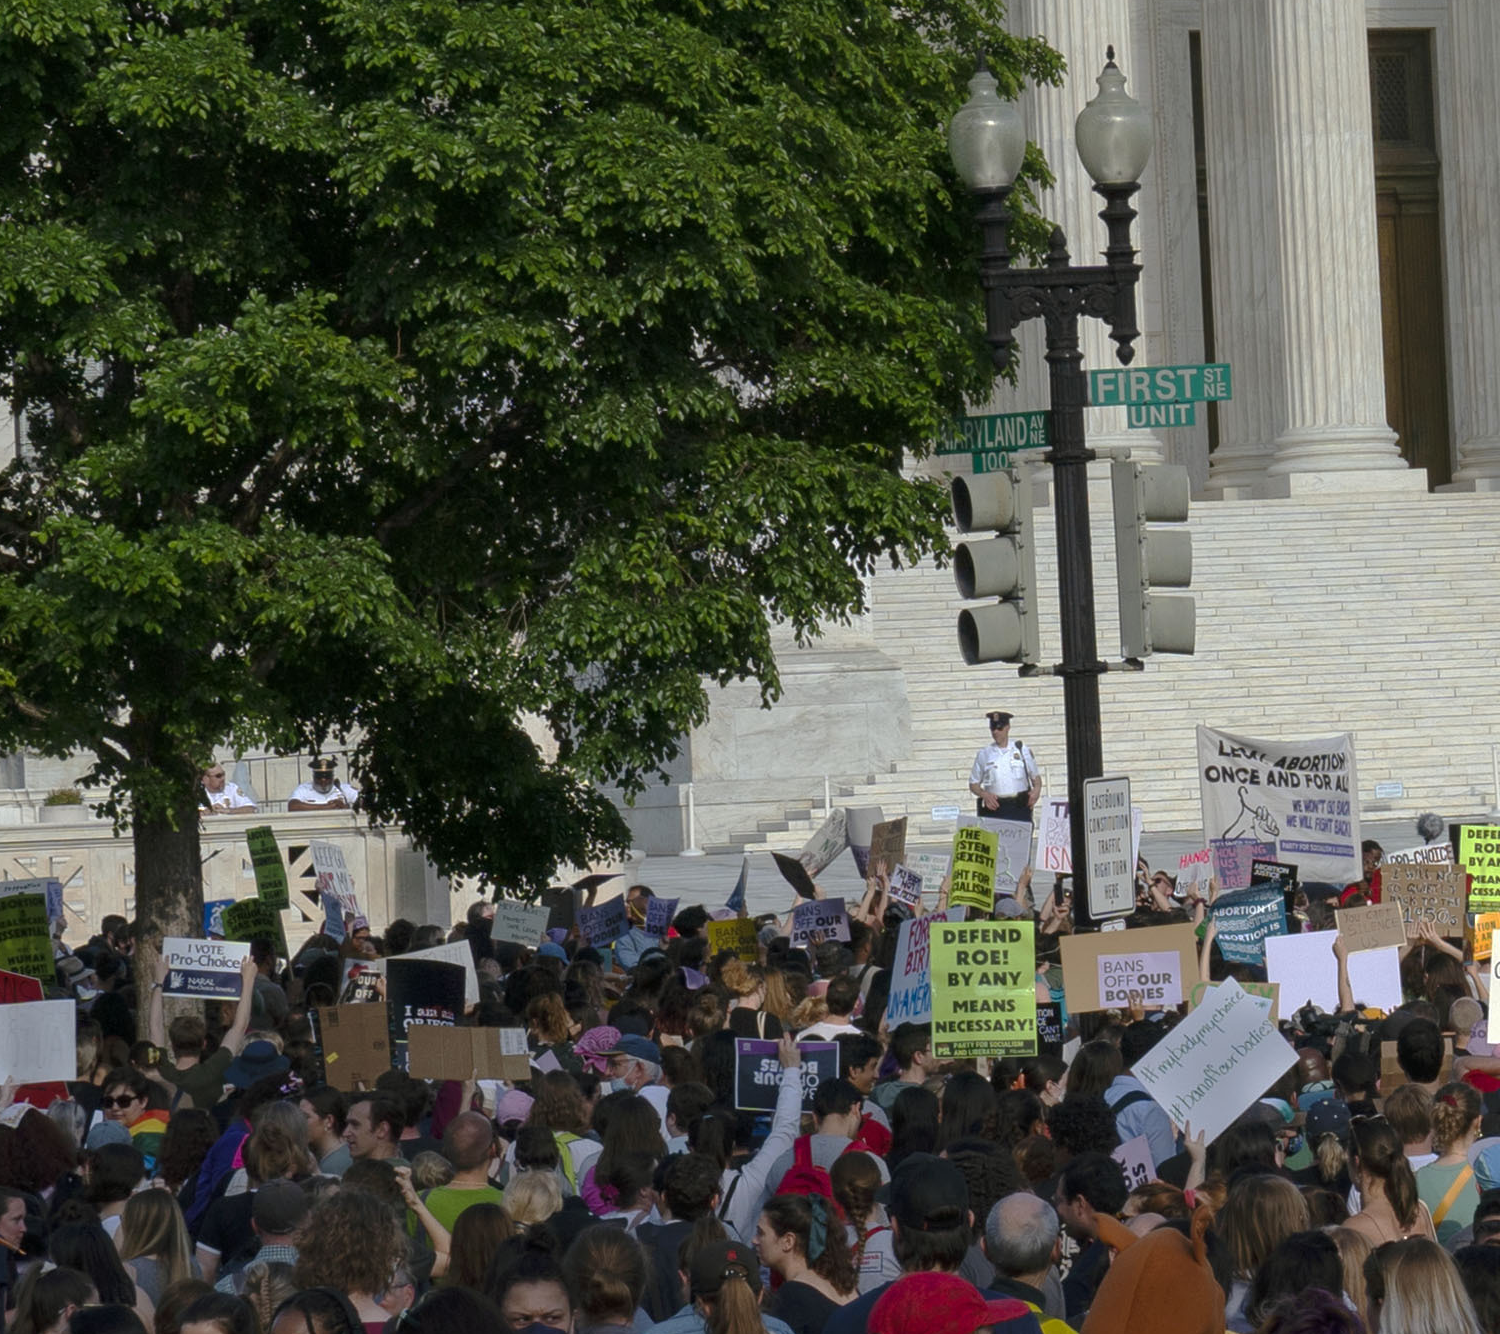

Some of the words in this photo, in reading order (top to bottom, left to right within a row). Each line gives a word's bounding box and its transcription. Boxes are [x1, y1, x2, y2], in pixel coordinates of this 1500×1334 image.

[1097, 368, 1197, 403] FIRST
[1204, 368, 1223, 383] ST
[1204, 383, 1227, 397] NE
[1030, 415, 1044, 430] AV
[1131, 404, 1190, 427] UNIT
[1030, 429, 1045, 444] NE
[981, 452, 1008, 471] 100
[1273, 753, 1345, 771] ABORTION
[1205, 765, 1260, 785] ONCE
[1267, 771, 1300, 787] AND
[1305, 774, 1332, 790] FOR
[1092, 792, 1124, 810] EASTBOUND
[1292, 800, 1303, 812] WE
[1089, 815, 1128, 833] CONSTITUTION
[1315, 818, 1332, 833] FIGHT
[960, 829, 980, 840] THE
[1099, 838, 1121, 854] TRAFFIC
[1179, 849, 1212, 869] HANDS
[1469, 857, 1485, 867] BY
[1094, 862, 1111, 878] RIGHT
[1112, 860, 1127, 875] TURN
[972, 871, 990, 885] FOR
[1104, 883, 1119, 899] HERE
[816, 916, 842, 927] OUR
[943, 929, 1022, 944] DEFEND
[1219, 926, 1267, 941] ABORTION
[194, 945, 224, 955] VOTE
[957, 950, 1009, 965] ROE!
[170, 954, 240, 967] Pro-Choice
[1104, 960, 1144, 973] BANS
[188, 977, 215, 986] NARAL
[948, 972, 971, 986] BY
[979, 971, 1022, 986] ANY
[1104, 976, 1134, 988] OFF
[1138, 974, 1172, 985] OUR
[953, 999, 1016, 1013] MEANS
[935, 1018, 1034, 1033] NECESSARY!
